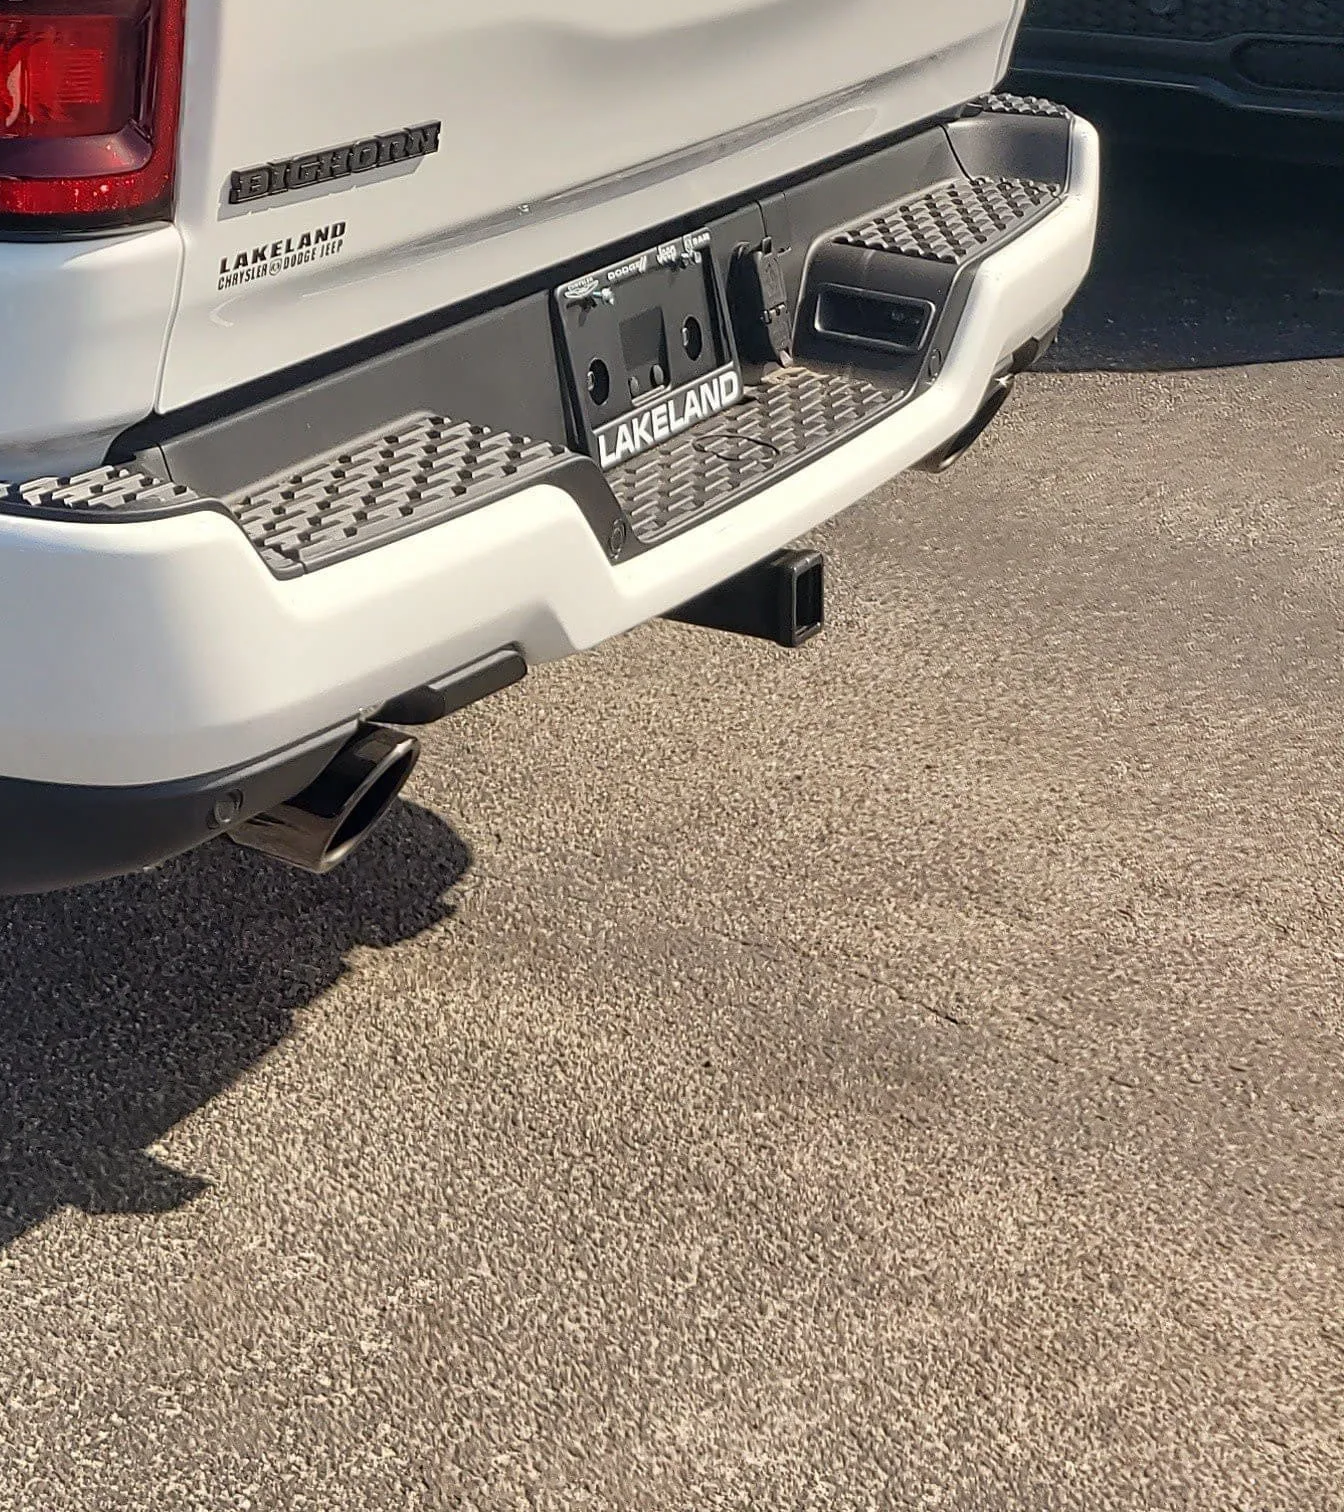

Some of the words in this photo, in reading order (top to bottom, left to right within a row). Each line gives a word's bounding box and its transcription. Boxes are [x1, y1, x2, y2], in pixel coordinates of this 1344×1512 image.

[217, 263, 268, 291] CHRYSLER
[283, 247, 317, 270] DODGE
[319, 238, 344, 258] JEEP
[219, 221, 346, 275] LAKELAND
[597, 370, 739, 468] LAKELAND
